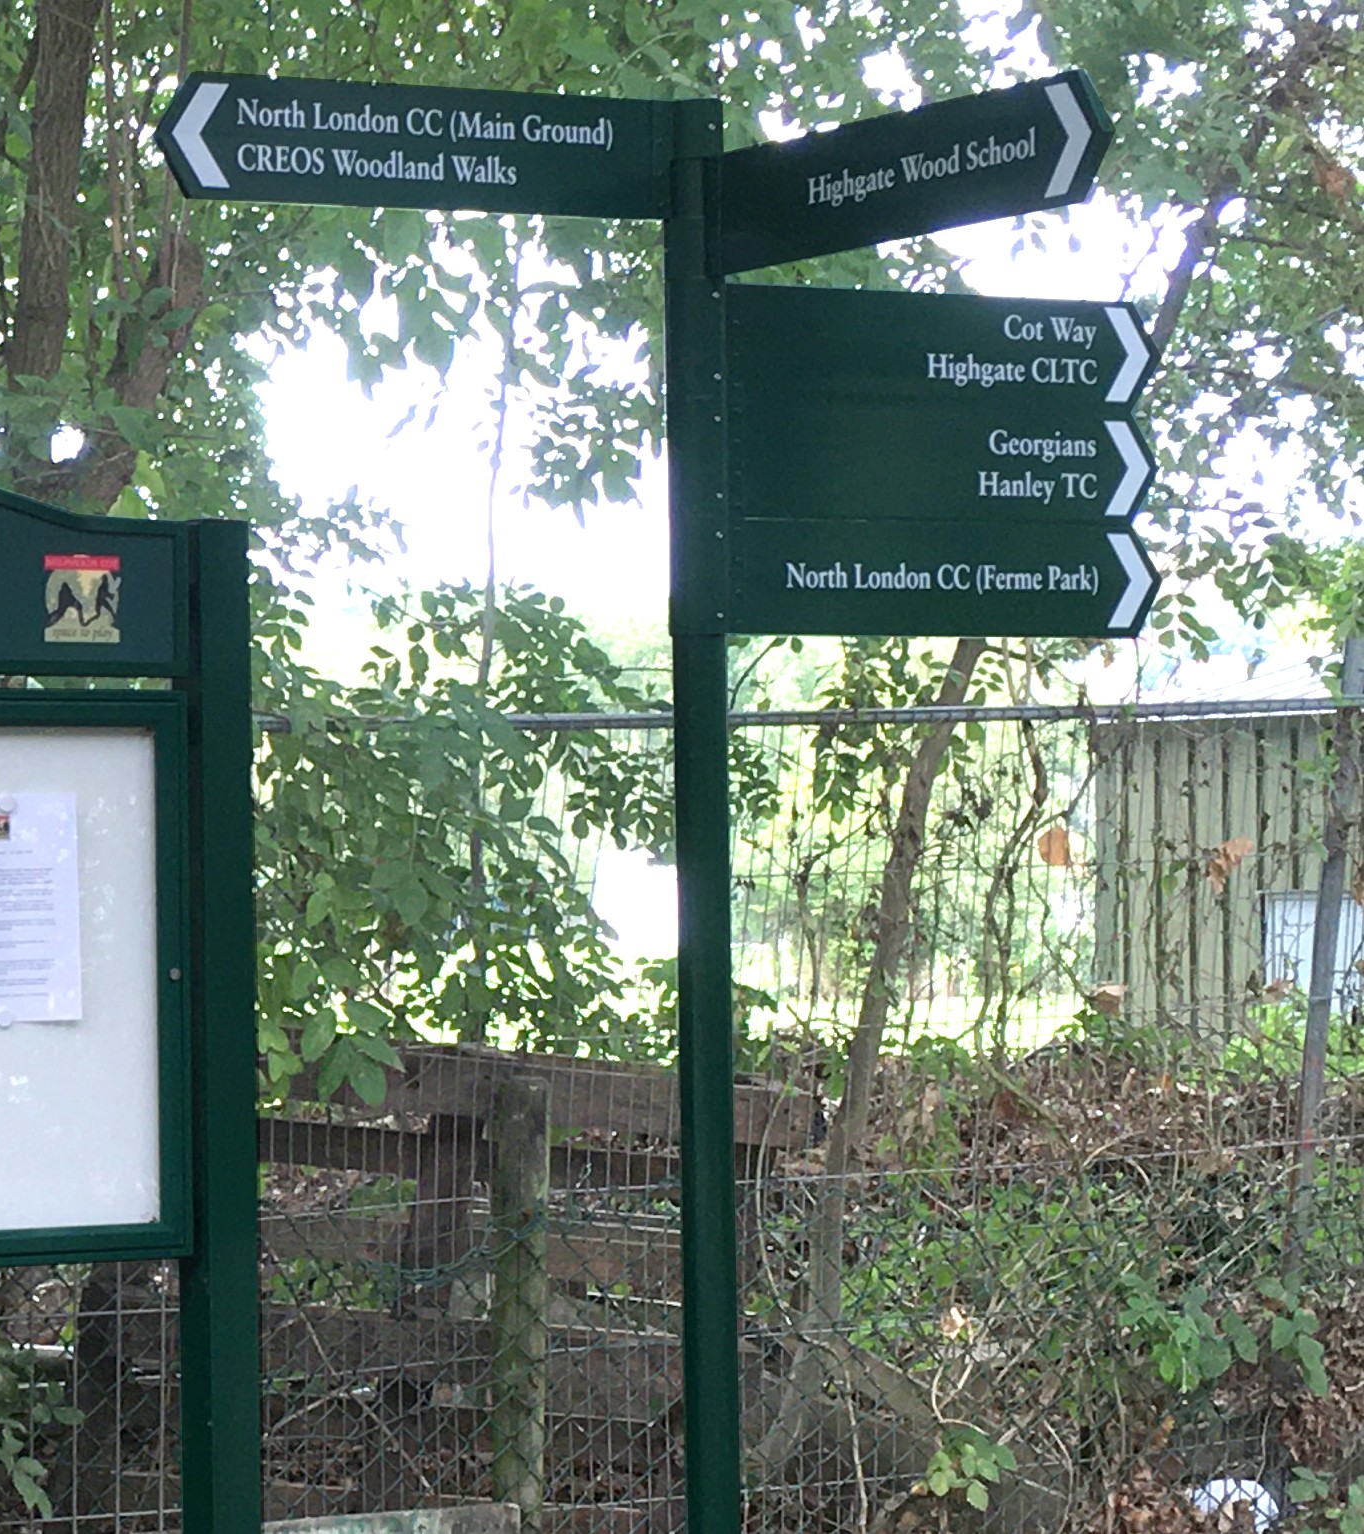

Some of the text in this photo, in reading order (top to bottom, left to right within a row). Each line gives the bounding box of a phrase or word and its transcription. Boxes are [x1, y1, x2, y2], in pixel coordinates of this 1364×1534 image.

[237, 98, 614, 151] North London CC (Main Ground)
[237, 143, 517, 186] CREOS Woodland Walks
[808, 126, 1036, 207] Highgate Wood School
[1003, 314, 1097, 350] Cot Way
[926, 353, 1098, 388] Highgate CLTC
[989, 429, 1097, 463] Georgians
[978, 471, 1098, 505] Hanley TC
[786, 562, 1100, 595] North London CC (Ferme Park)
